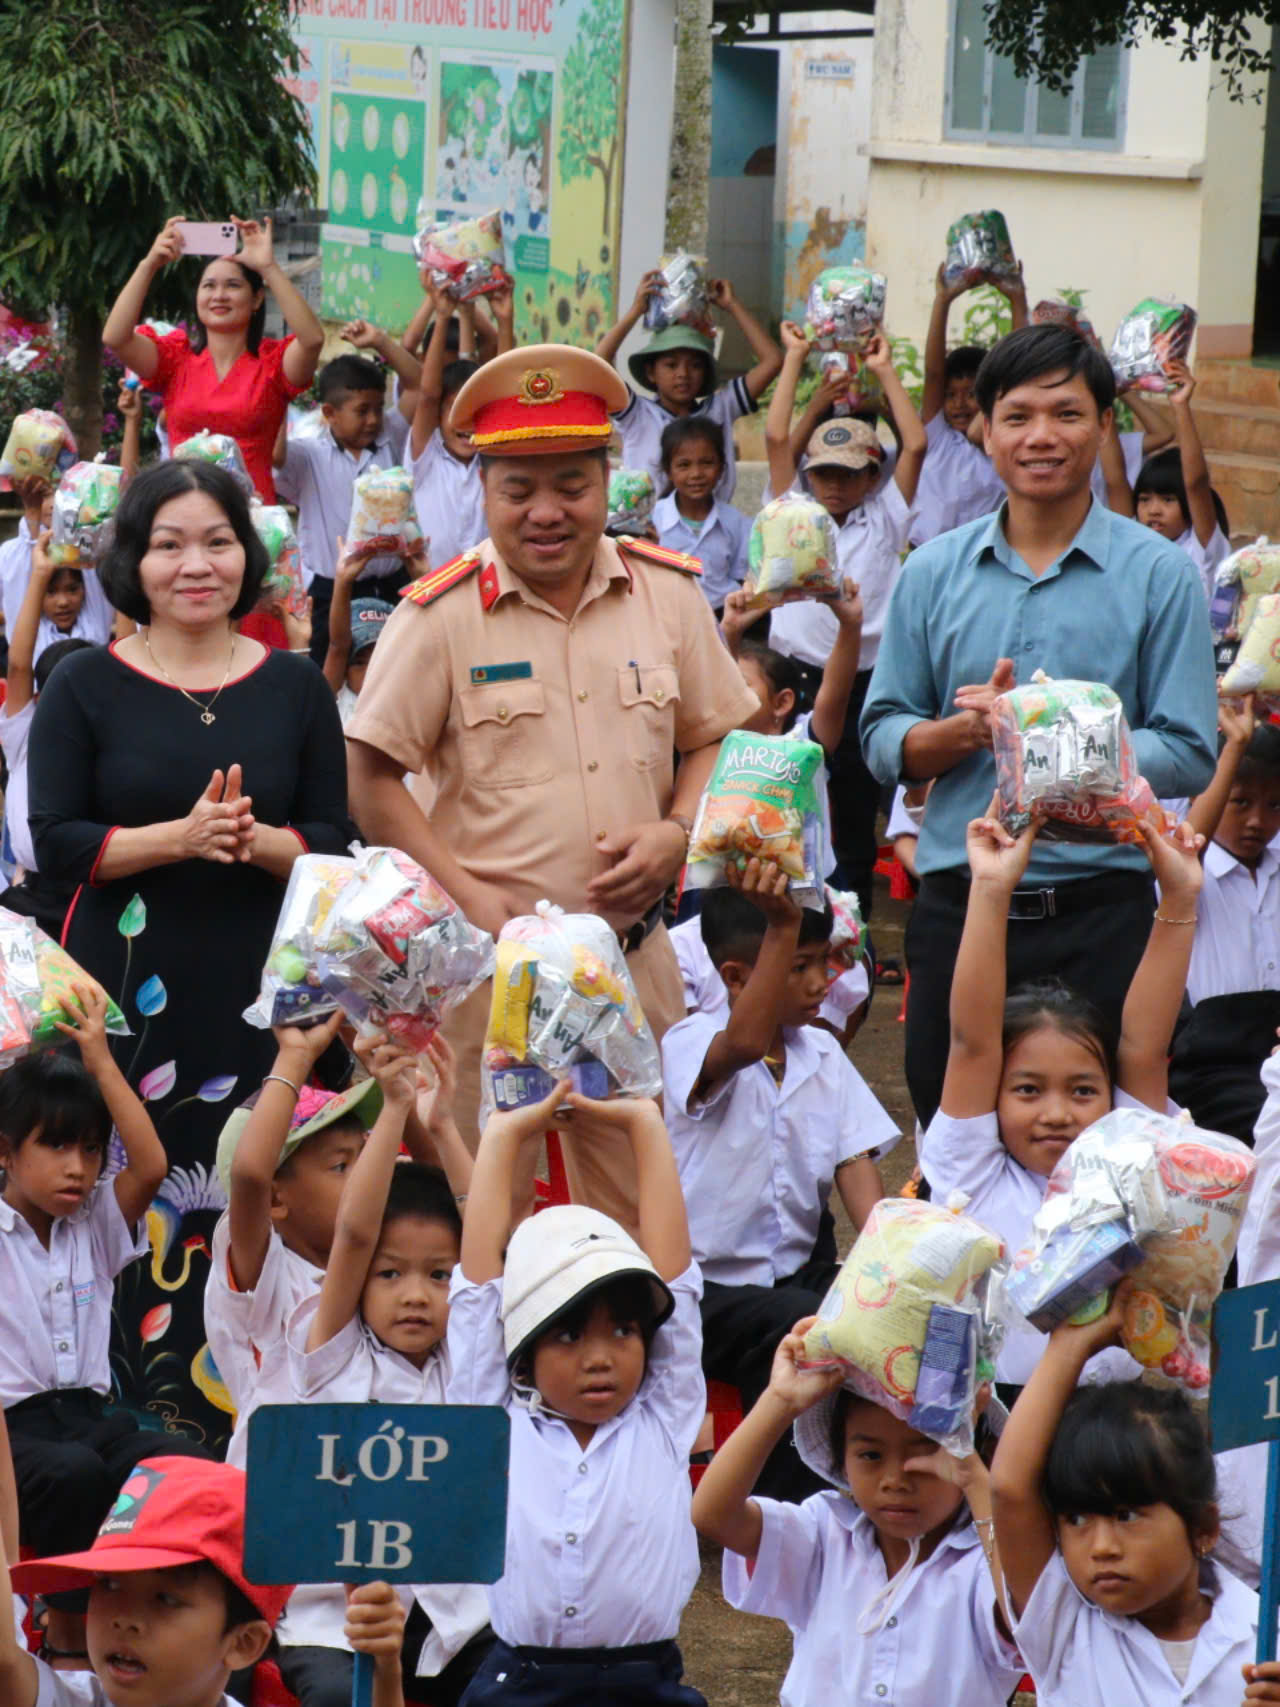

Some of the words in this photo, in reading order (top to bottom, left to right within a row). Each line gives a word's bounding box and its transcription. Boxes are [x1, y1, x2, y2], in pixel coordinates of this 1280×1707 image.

[1022, 747, 1051, 771] An
[1081, 734, 1109, 761] An
[9, 941, 35, 964] An
[553, 1022, 585, 1054] An
[315, 1419, 449, 1486] LỚP
[334, 1519, 413, 1570] 1B
